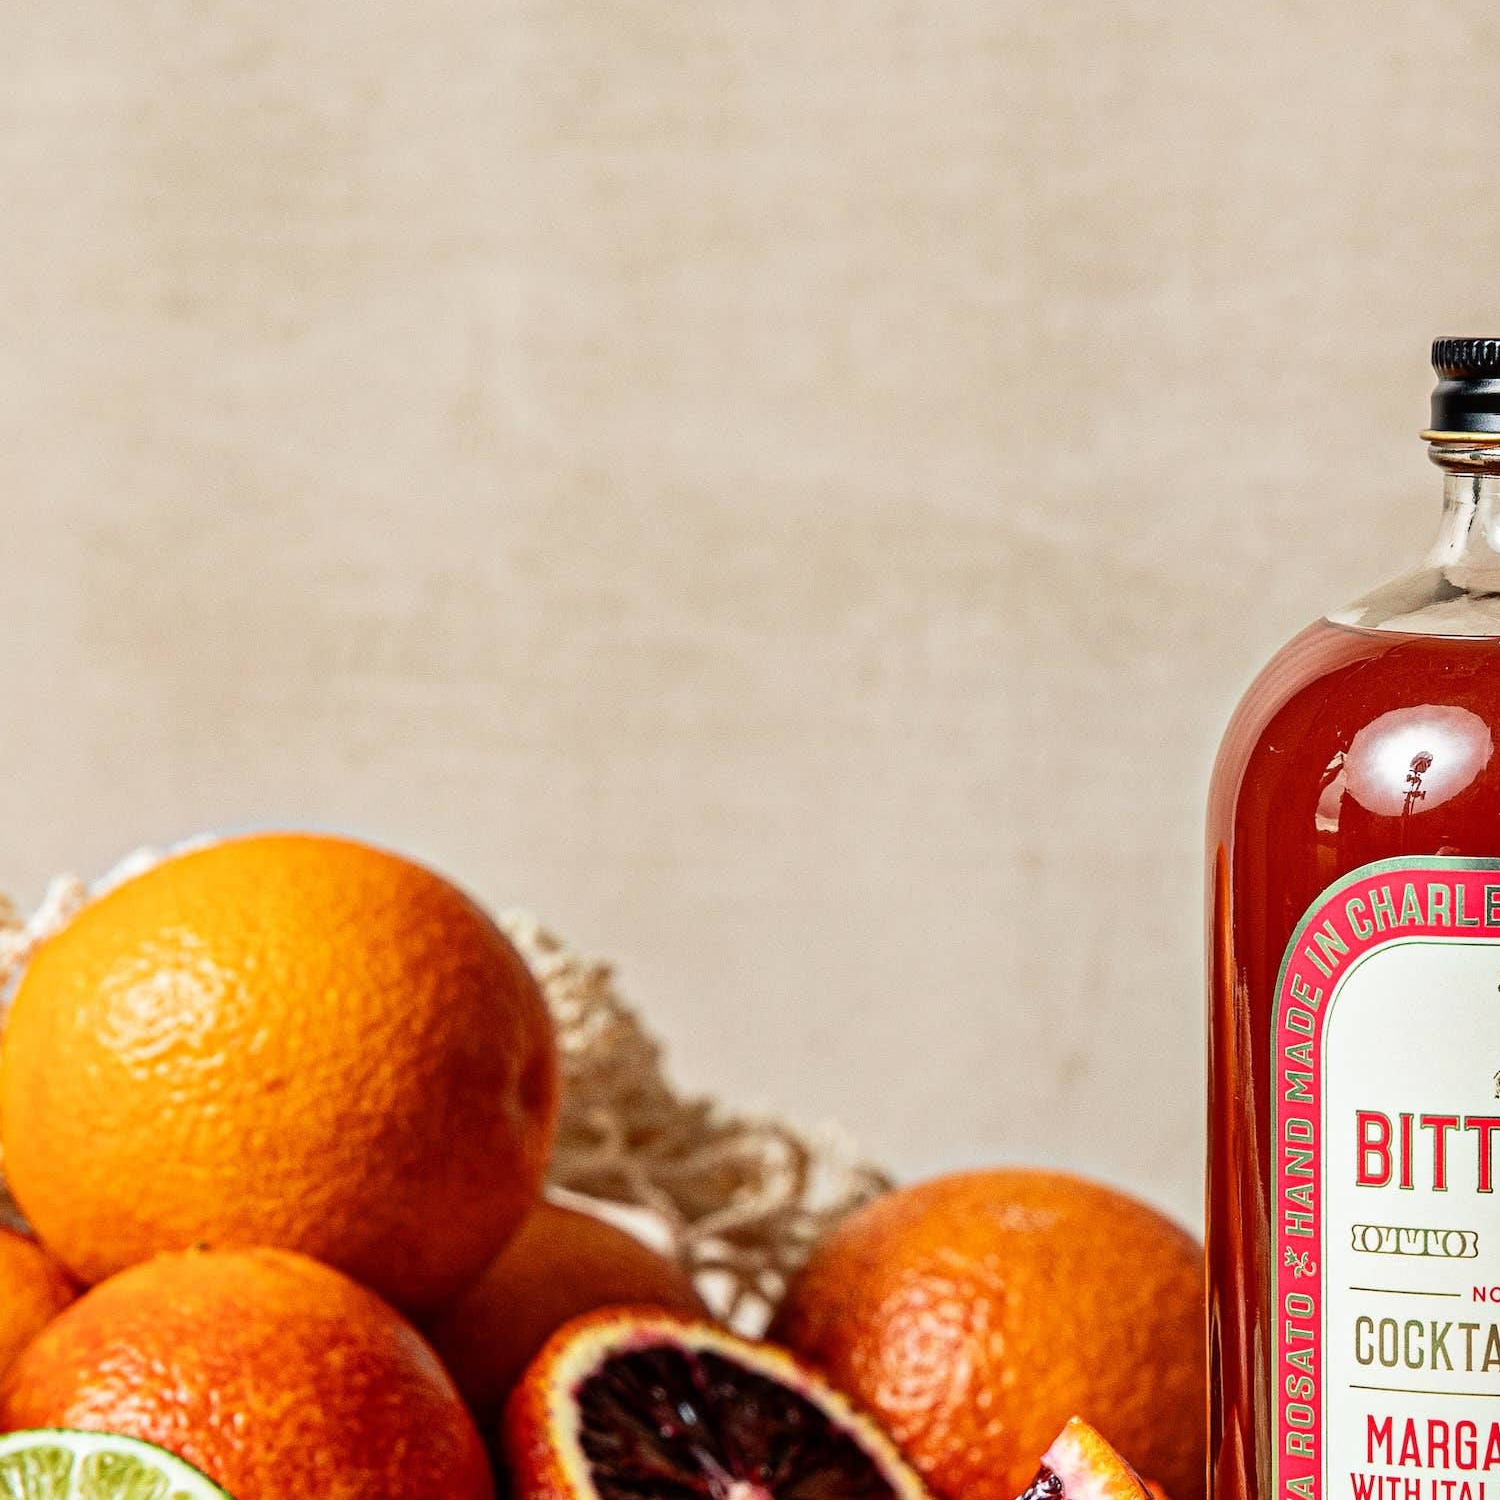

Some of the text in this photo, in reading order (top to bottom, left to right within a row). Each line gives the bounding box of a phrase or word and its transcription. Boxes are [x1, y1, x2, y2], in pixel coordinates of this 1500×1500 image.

[1306, 924, 1349, 978] IN
[1285, 974, 1323, 1104] MADE
[1285, 1116, 1315, 1238] HAND
[1285, 1291, 1316, 1460] ROSATO
